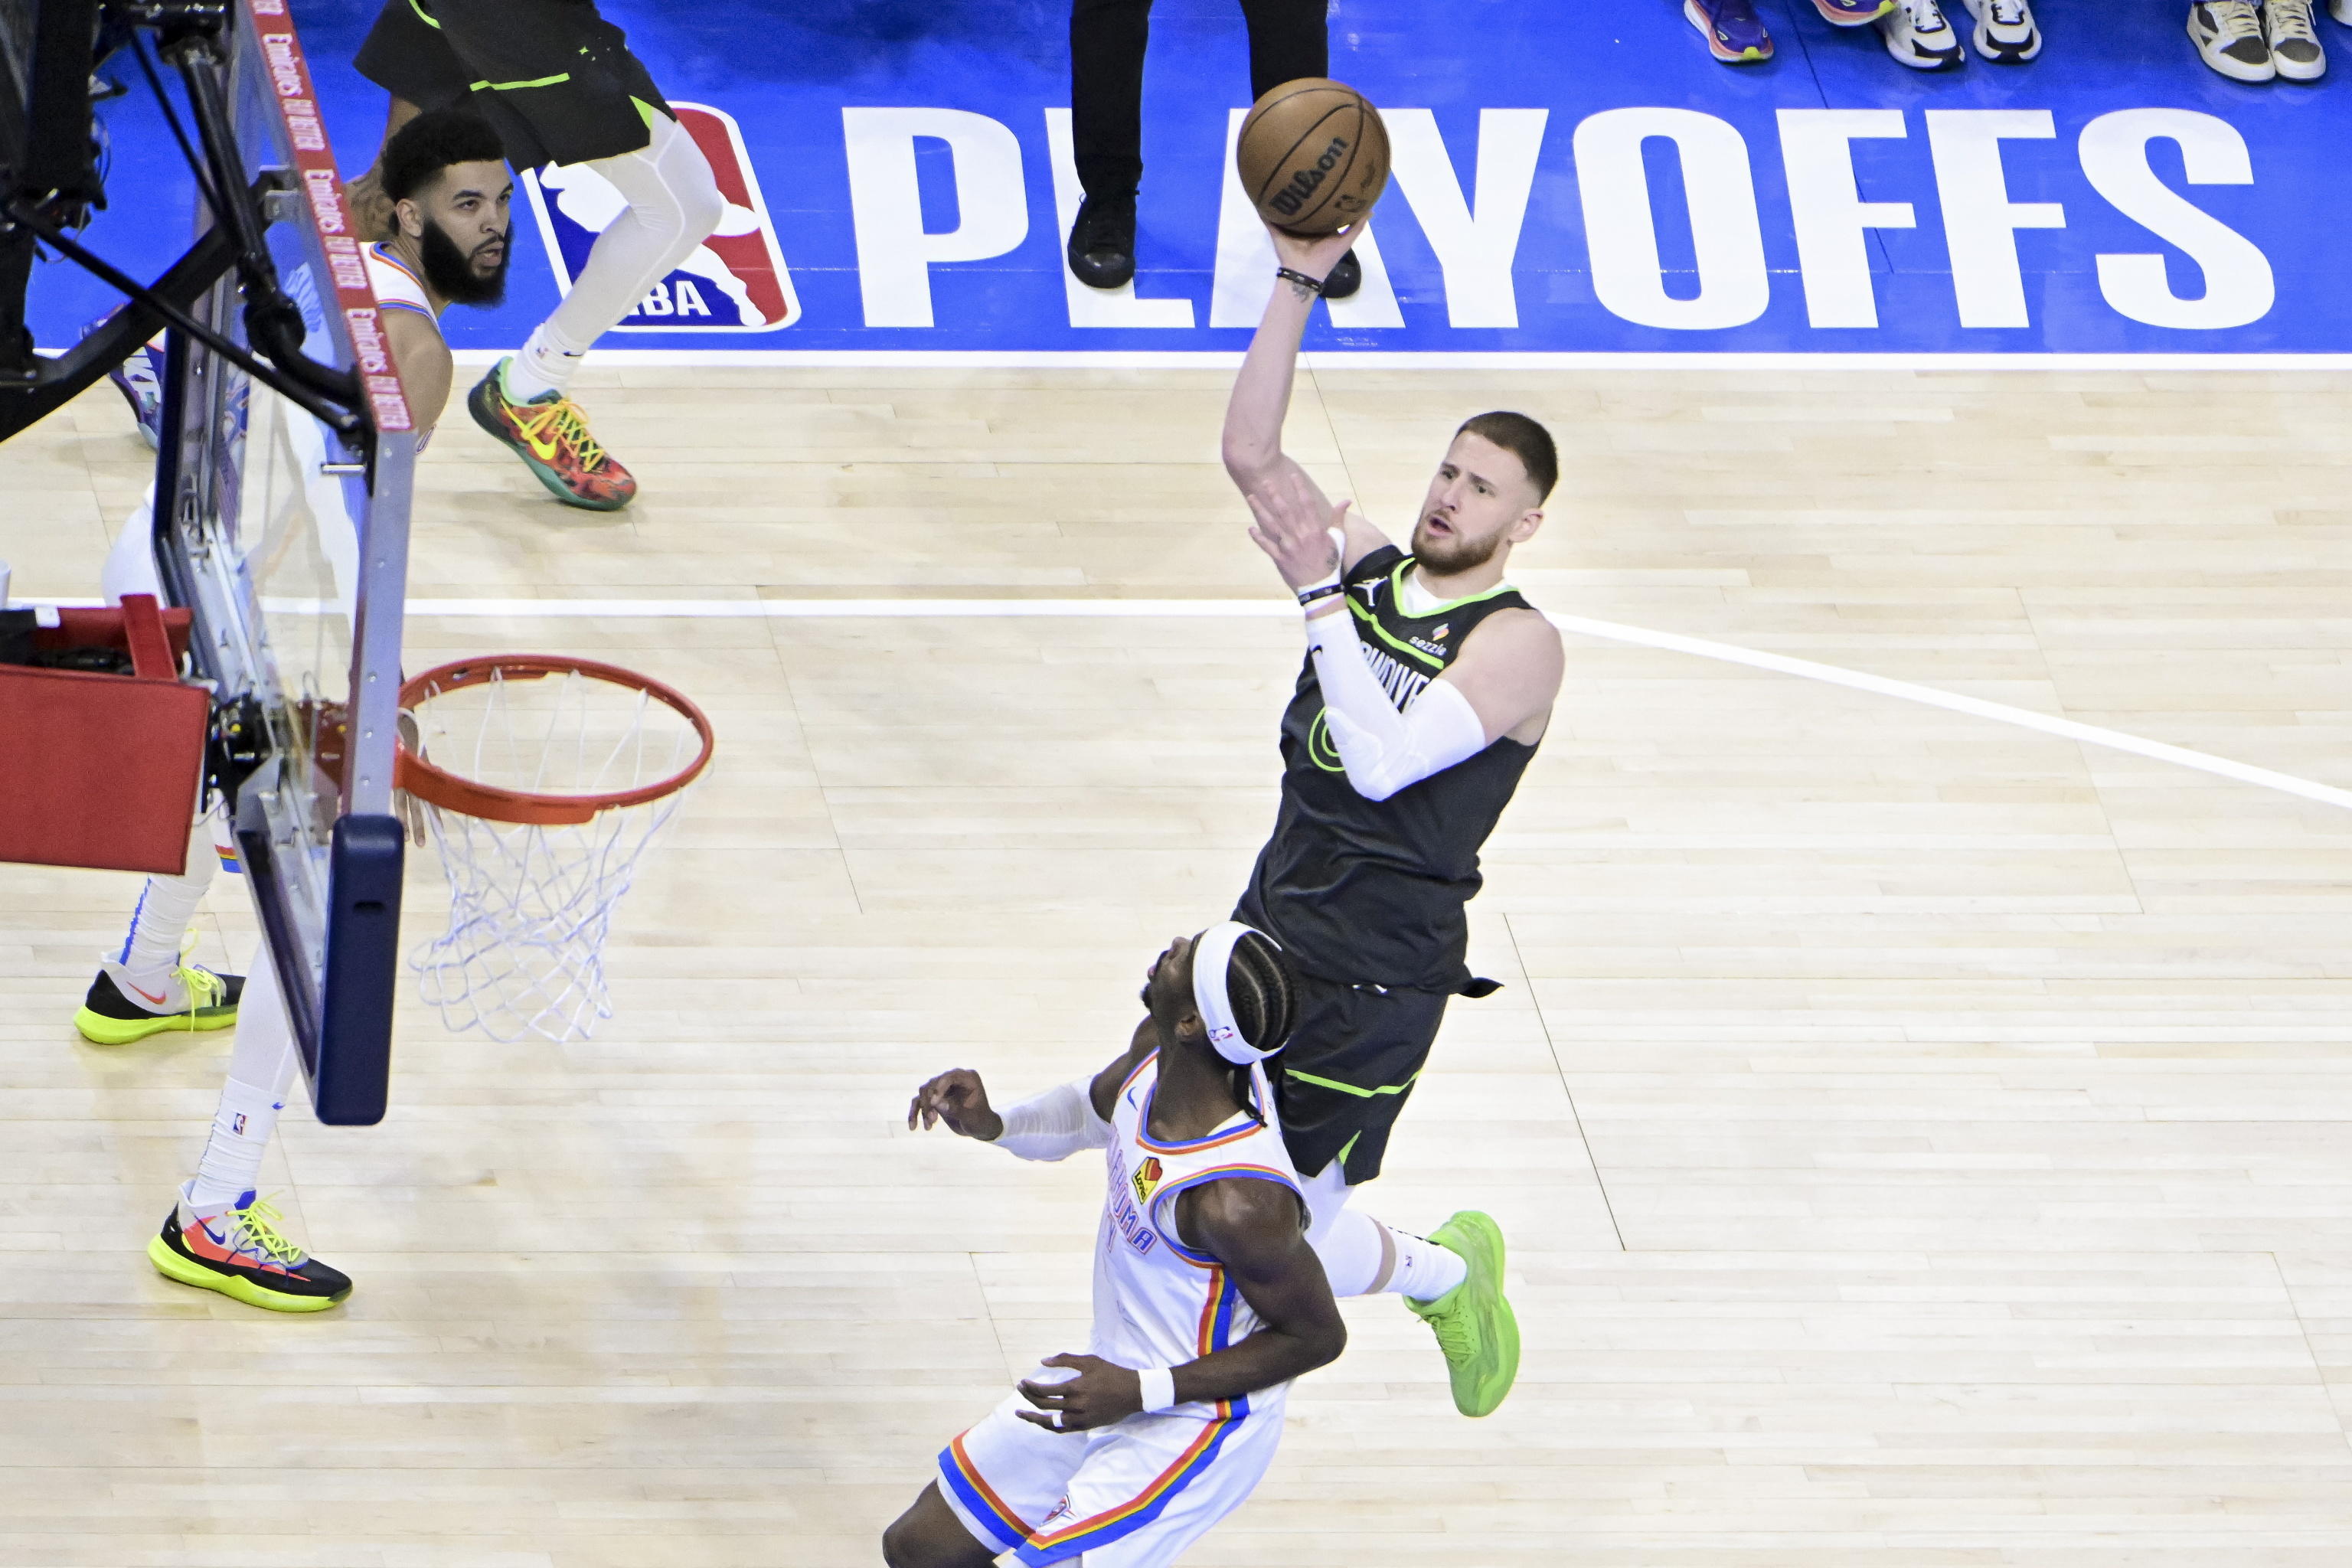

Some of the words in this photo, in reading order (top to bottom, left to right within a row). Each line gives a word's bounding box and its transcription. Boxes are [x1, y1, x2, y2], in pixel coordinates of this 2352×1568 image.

[1269, 137, 1348, 215] Wilson
[626, 280, 712, 315] BA
[1410, 636, 1446, 656] sezzle
